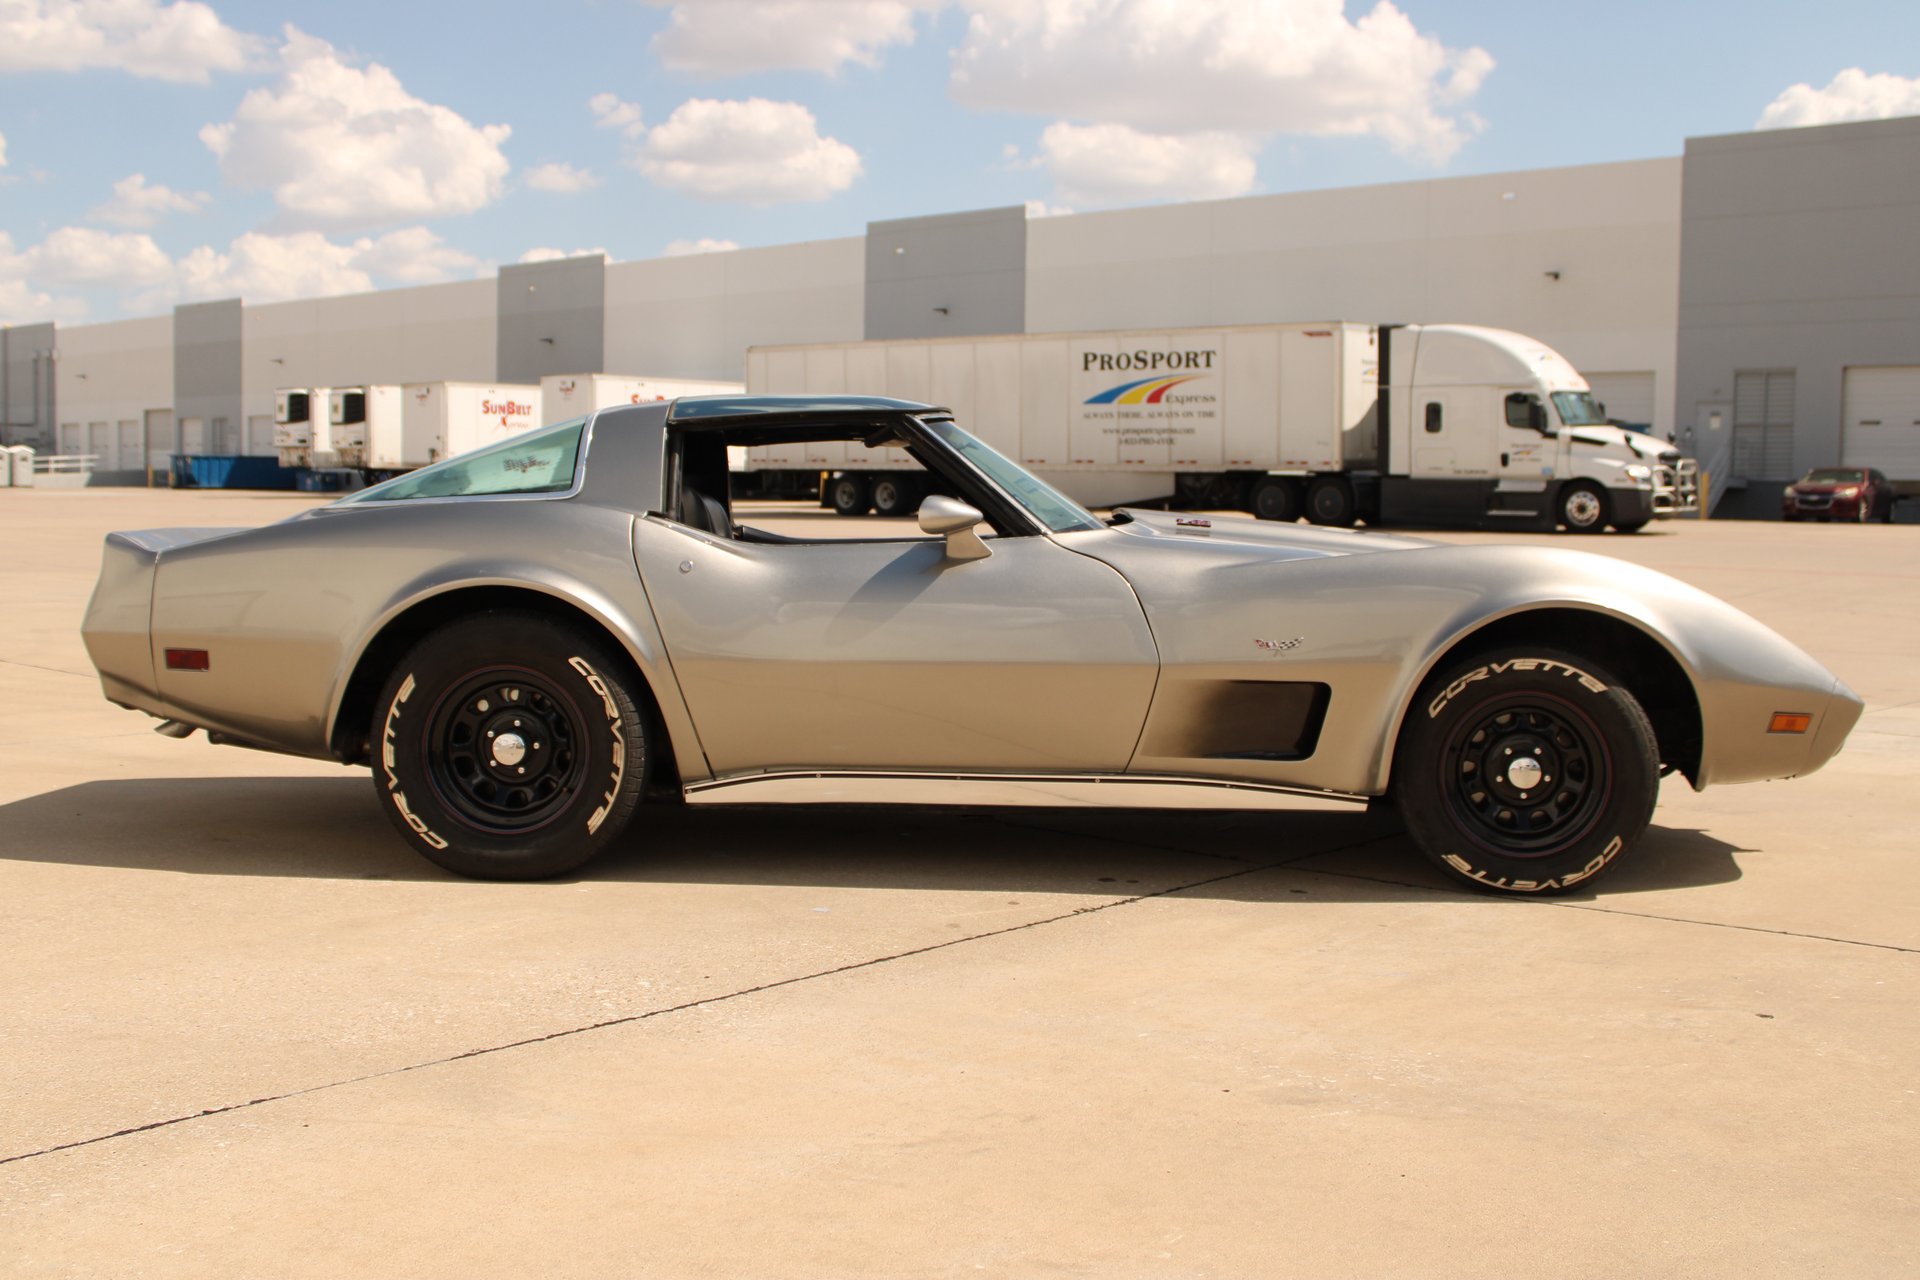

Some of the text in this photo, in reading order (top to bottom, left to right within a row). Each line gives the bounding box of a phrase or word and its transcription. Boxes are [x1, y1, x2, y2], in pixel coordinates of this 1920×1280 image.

[1165, 393, 1216, 406] Express
[1428, 658, 1609, 719] CORVETTE
[382, 673, 449, 850] CORVETTE
[568, 656, 626, 836] CORVETTE
[1440, 835, 1623, 892] CORVETTE
